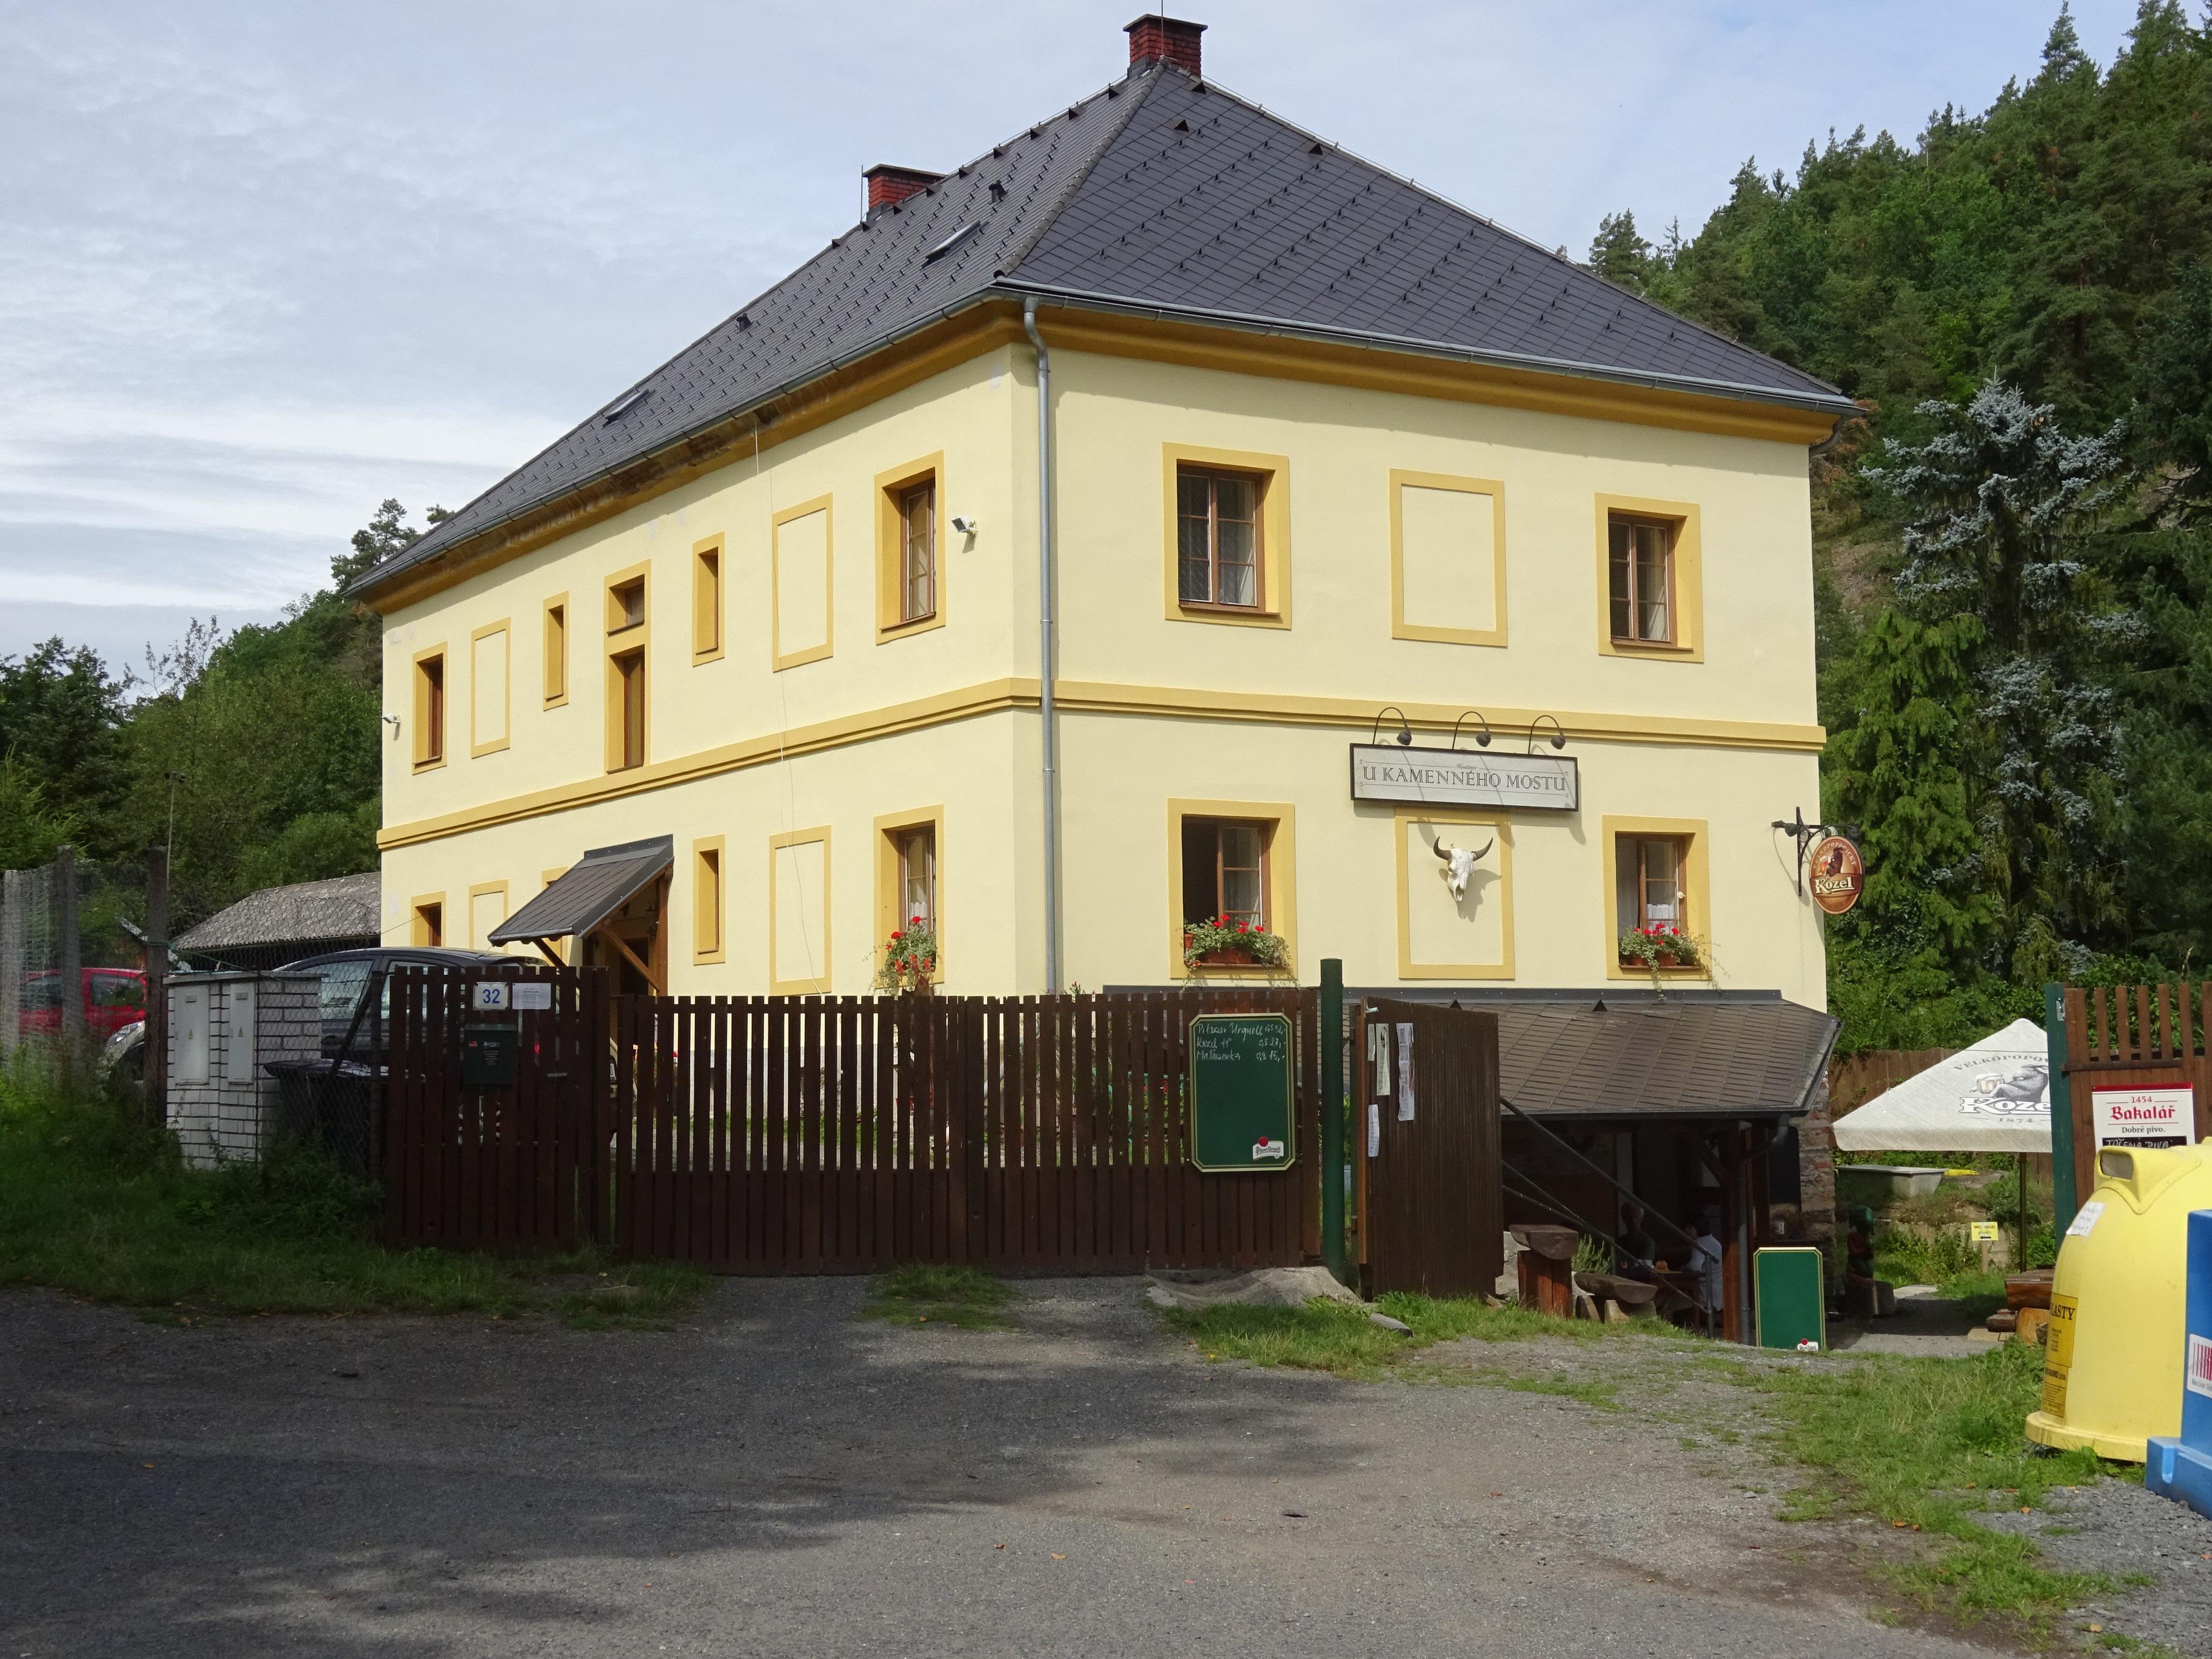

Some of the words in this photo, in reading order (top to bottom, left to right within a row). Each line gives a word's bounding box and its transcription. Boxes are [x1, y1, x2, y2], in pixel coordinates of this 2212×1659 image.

[1363, 766, 1376, 781] U
[1383, 767, 1501, 787] KAMENNÉHO
[1507, 774, 1566, 791] MOSTU
[1815, 876, 1855, 894] Kozel
[483, 988, 500, 1004] 32
[1229, 1022, 1263, 1041] Urquell
[1959, 1096, 2051, 1115] Koze
[2110, 1105, 2176, 1121] Bakalář
[2147, 1126, 2165, 1134] pivo.
